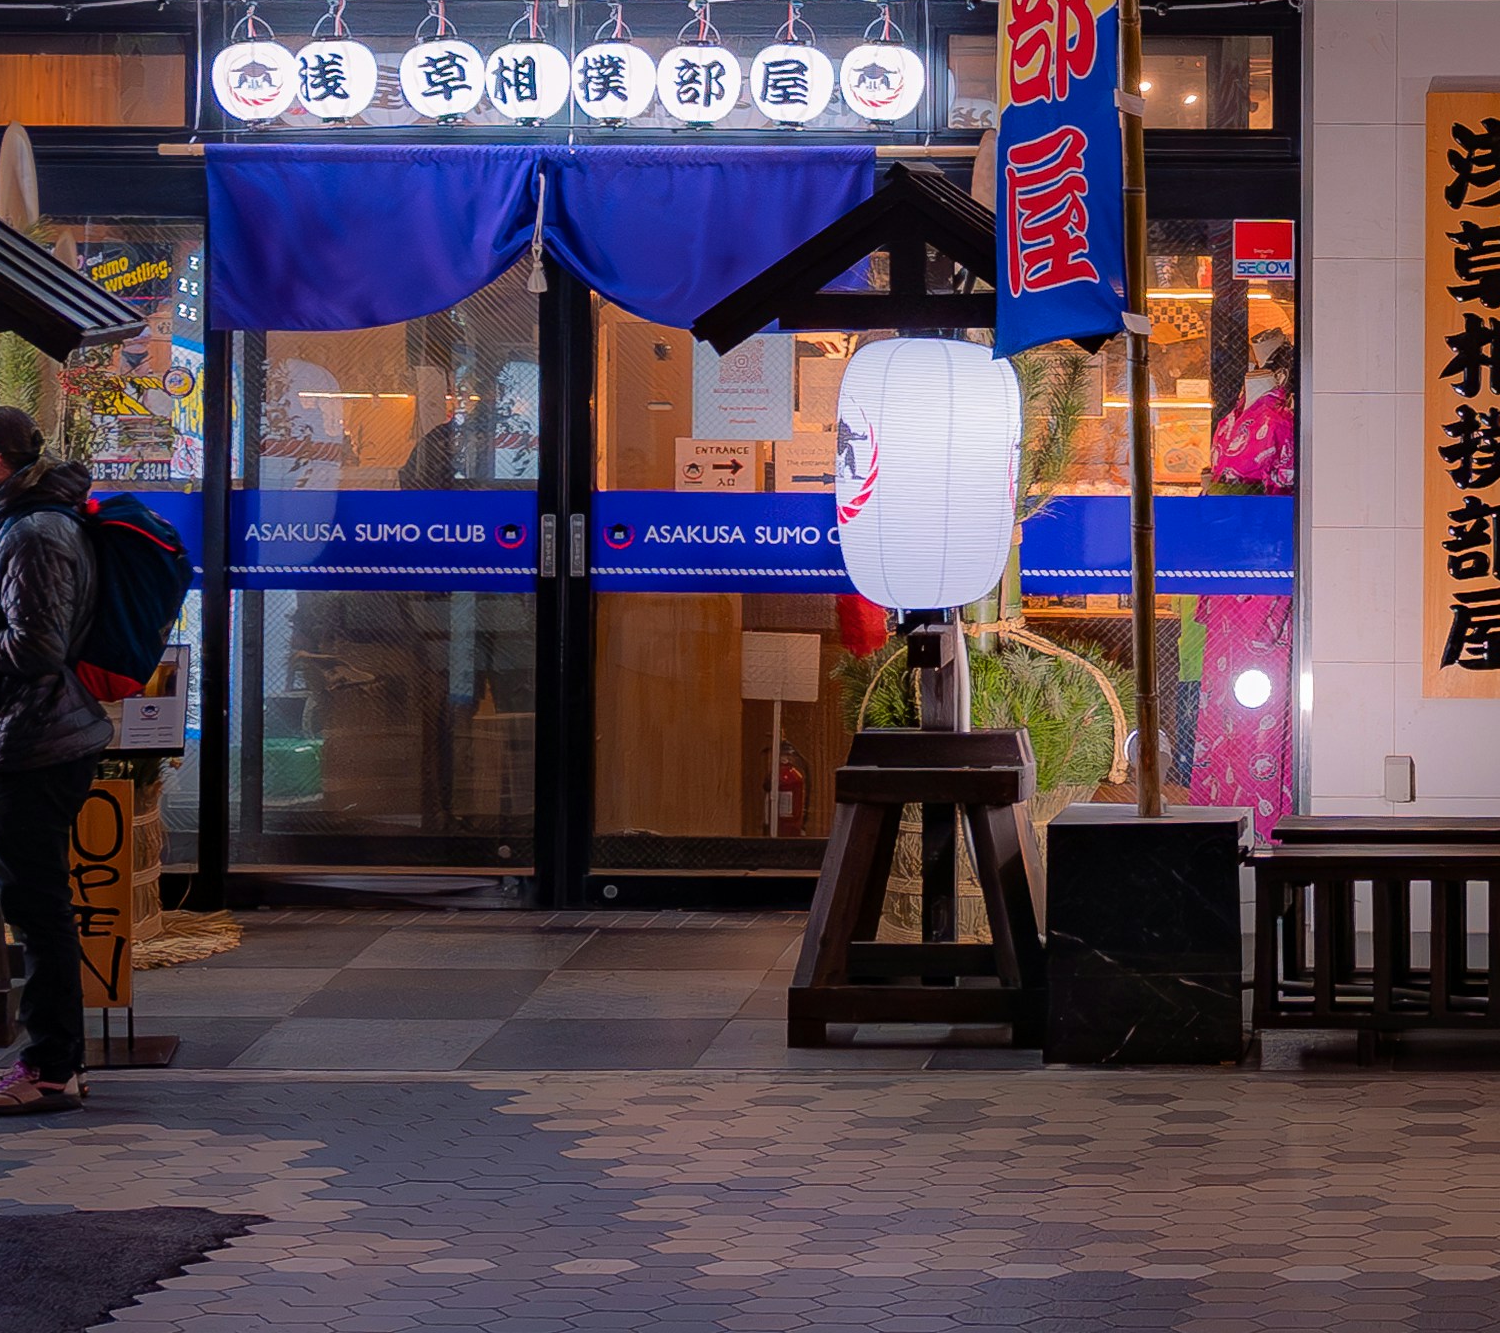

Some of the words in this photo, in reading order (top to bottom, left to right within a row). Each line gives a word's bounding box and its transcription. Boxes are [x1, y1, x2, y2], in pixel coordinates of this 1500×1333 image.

[298, 51, 810, 108] 浅草相撲部屋
[91, 256, 129, 281] sumo
[1237, 261, 1290, 274] SECOM
[695, 446, 750, 455] ENTRANCE
[245, 523, 347, 543] ASAKUSA
[354, 522, 421, 544] SUMO
[426, 522, 486, 544] CLUB
[644, 525, 746, 546] ASAKUSA
[754, 524, 821, 546] SUMO
